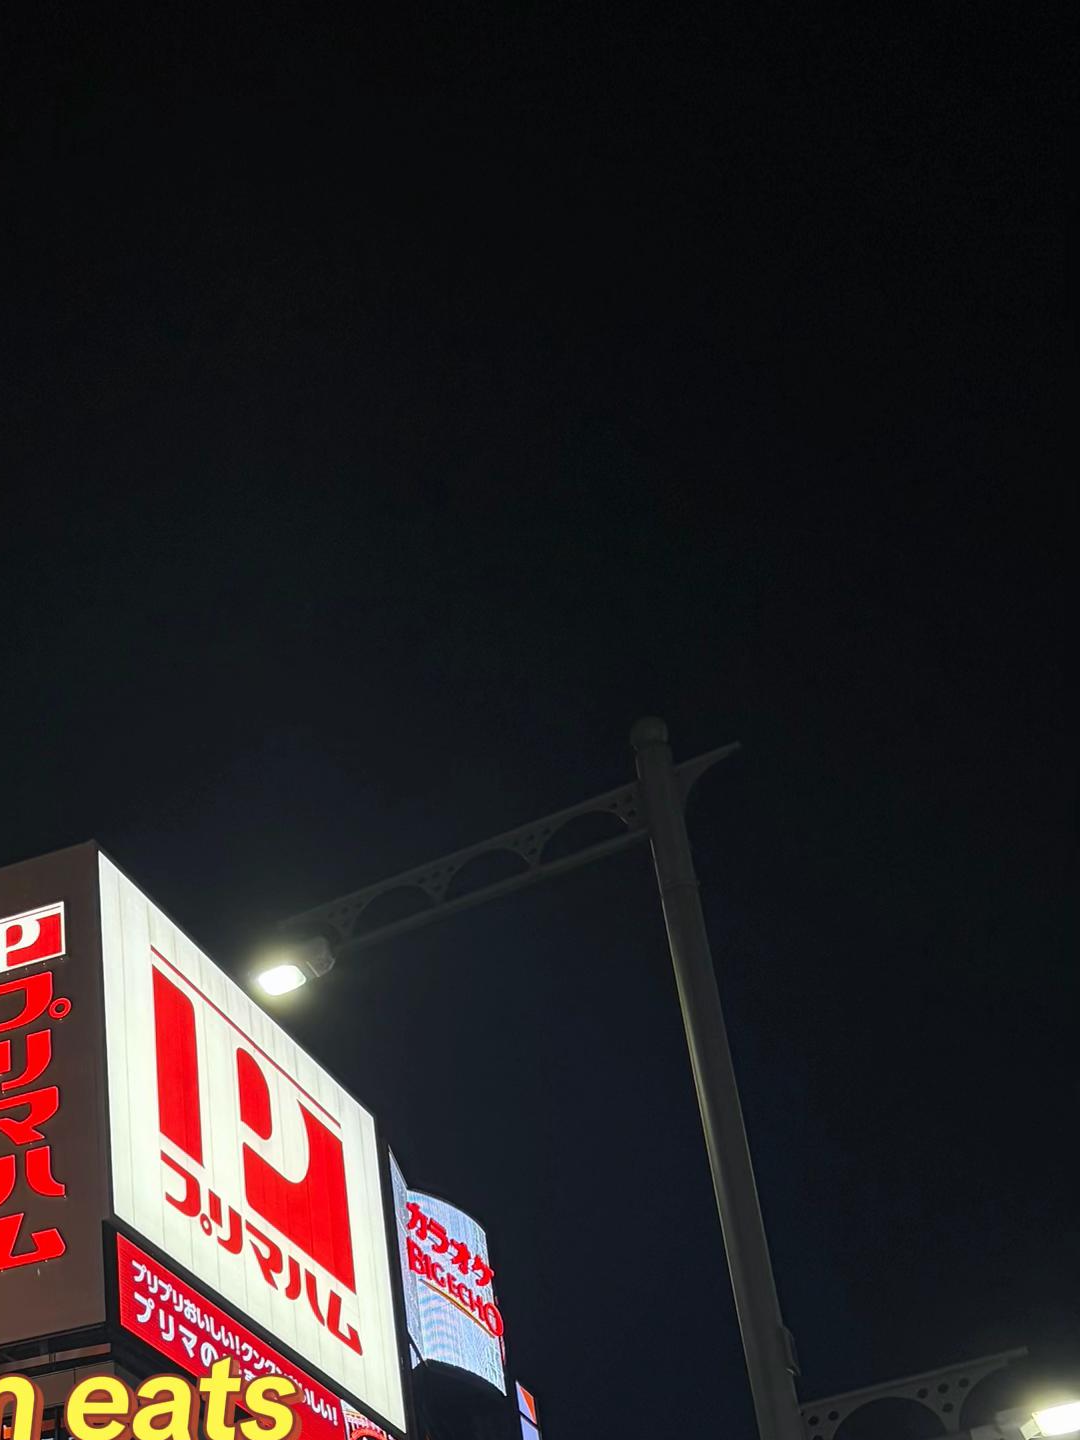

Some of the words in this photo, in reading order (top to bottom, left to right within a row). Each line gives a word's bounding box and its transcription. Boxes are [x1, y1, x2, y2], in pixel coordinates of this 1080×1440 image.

[160, 1149, 363, 1356] プリマハム
[406, 1200, 495, 1288] カラオケ
